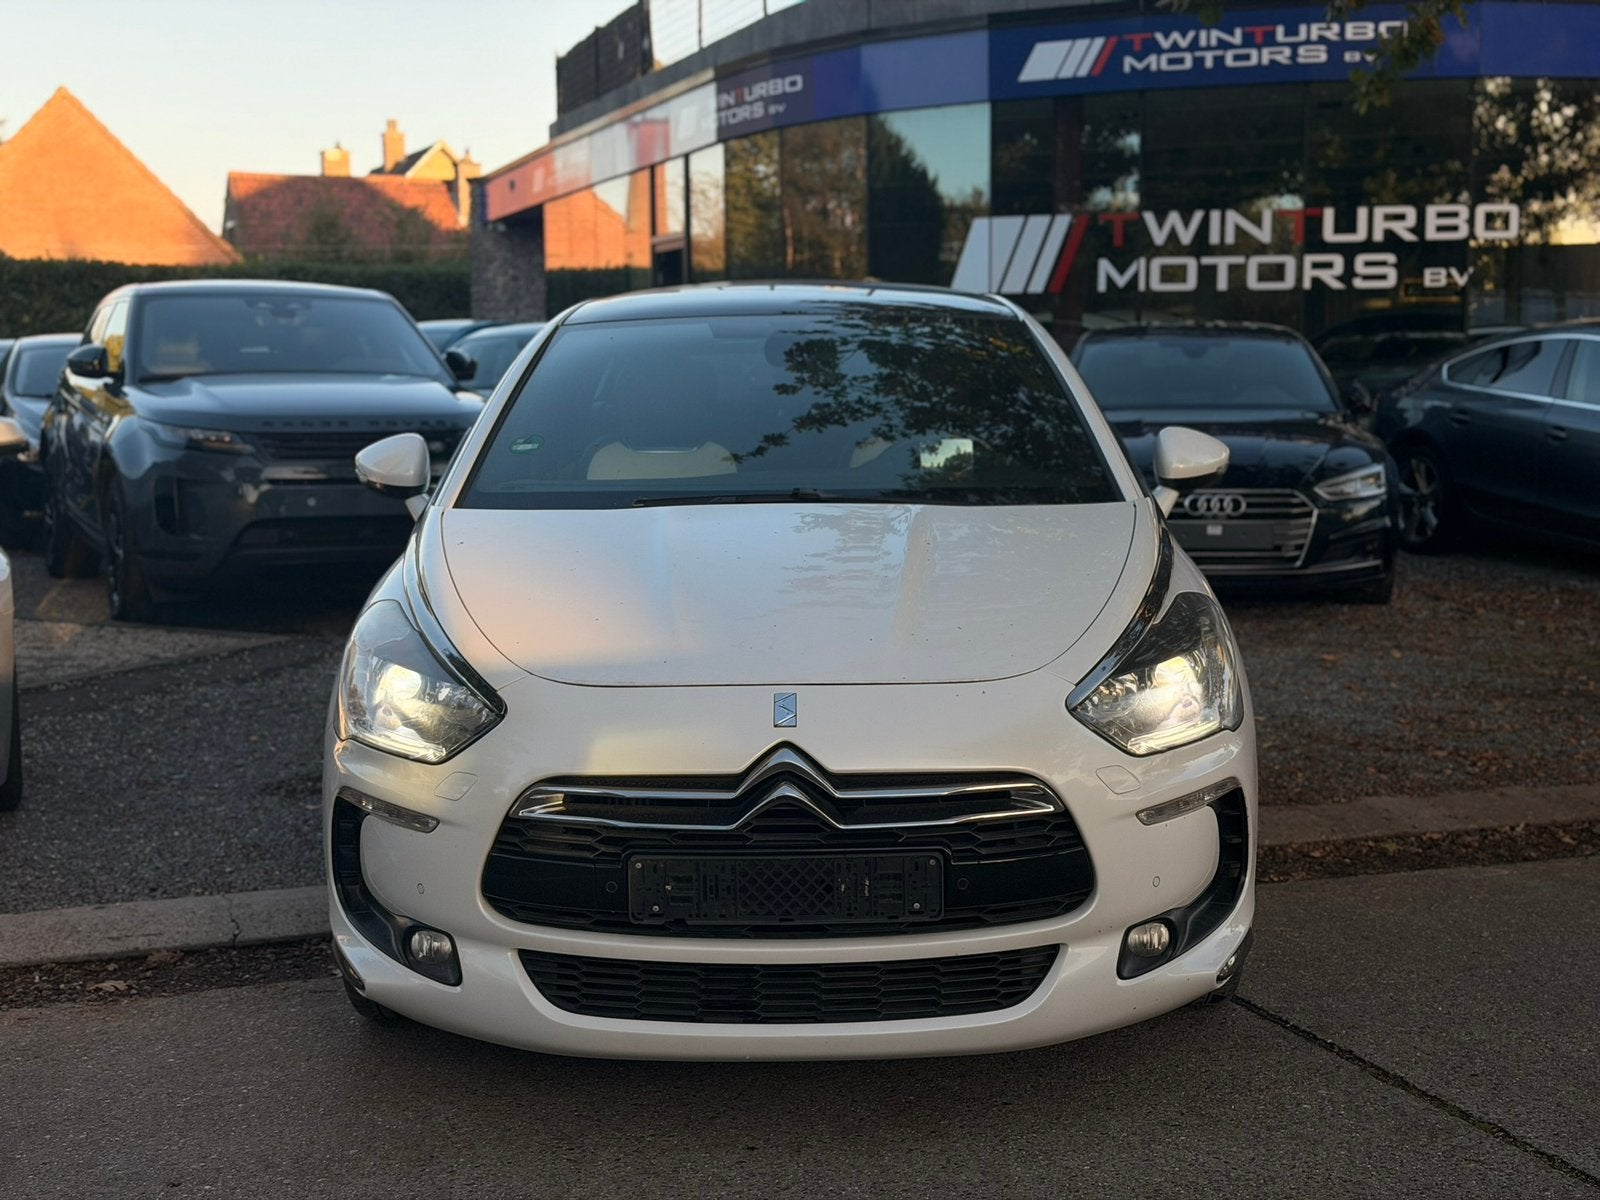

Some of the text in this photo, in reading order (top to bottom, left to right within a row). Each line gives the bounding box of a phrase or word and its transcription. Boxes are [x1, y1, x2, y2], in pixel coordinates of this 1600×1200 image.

[1122, 44, 1328, 74] MOTORS
[718, 74, 803, 108] INTURBO
[717, 101, 764, 126] TORS
[1098, 203, 1520, 248] TWINTURBO
[1097, 252, 1474, 293] MOTORS BV
